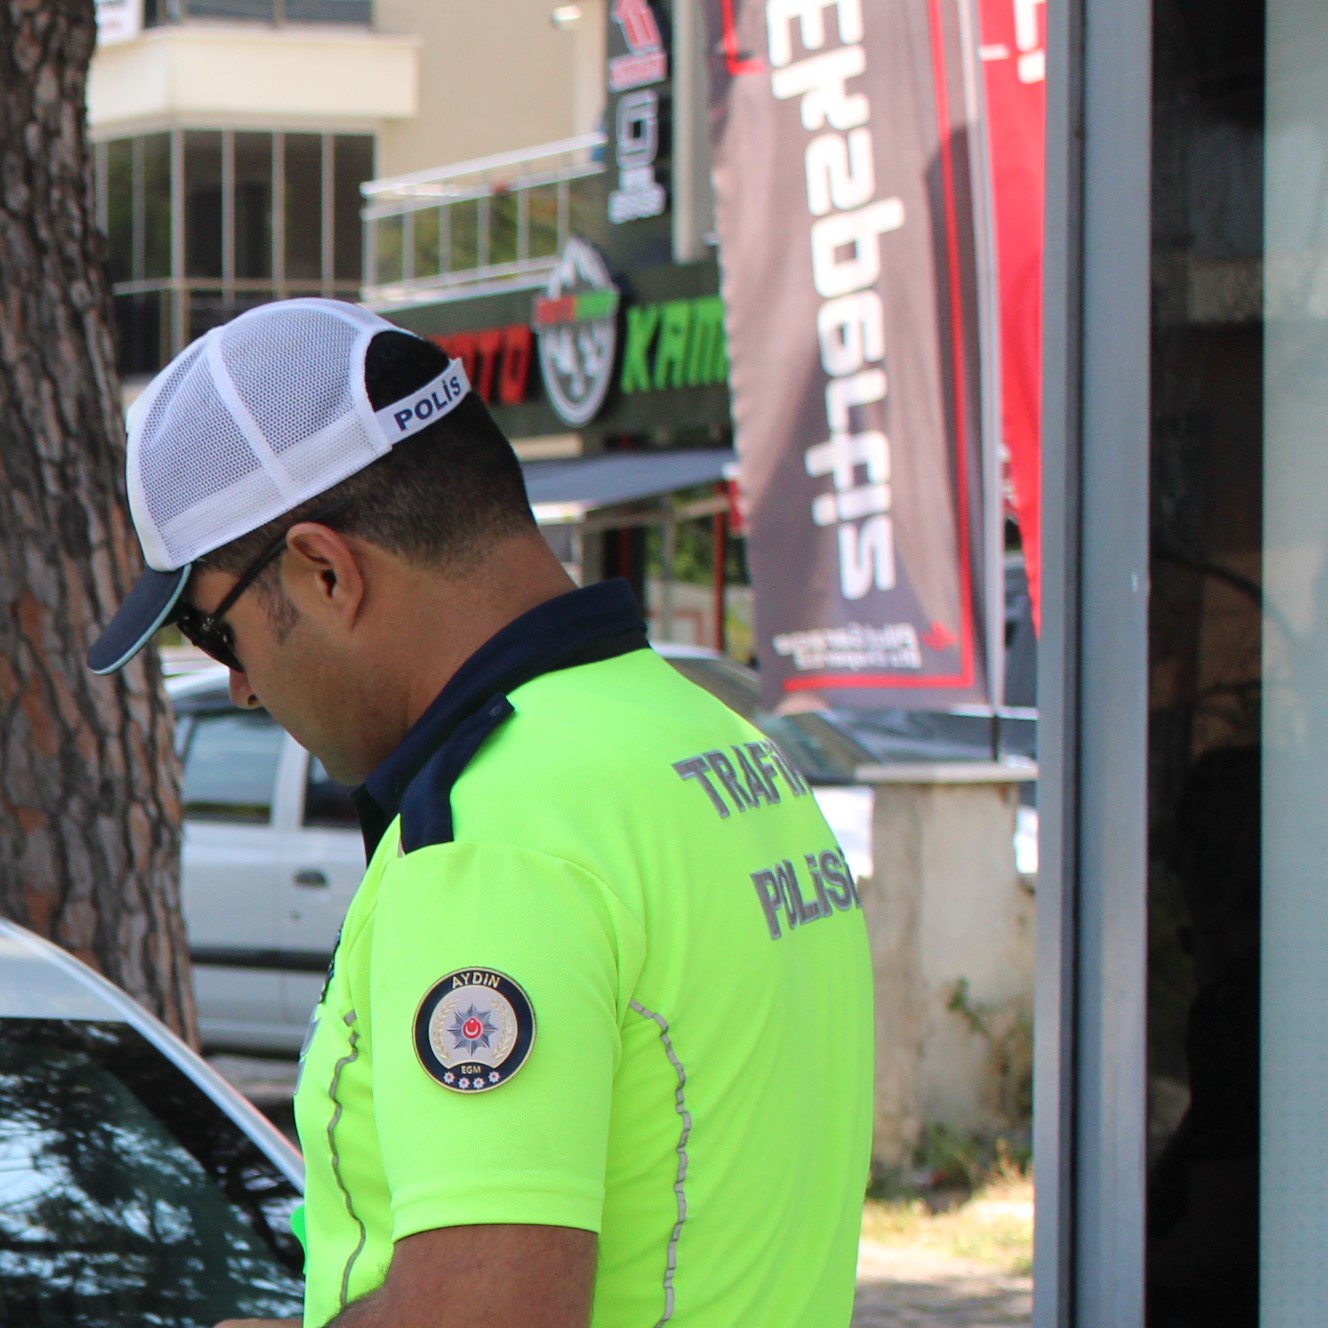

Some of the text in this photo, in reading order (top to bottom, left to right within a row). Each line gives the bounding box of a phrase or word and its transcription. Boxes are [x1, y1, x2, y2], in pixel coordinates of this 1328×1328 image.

[393, 375, 462, 432] POLİS
[671, 739, 812, 819] TRAFİ
[451, 971, 501, 989] AYDIN
[460, 1065, 482, 1075] EGM
